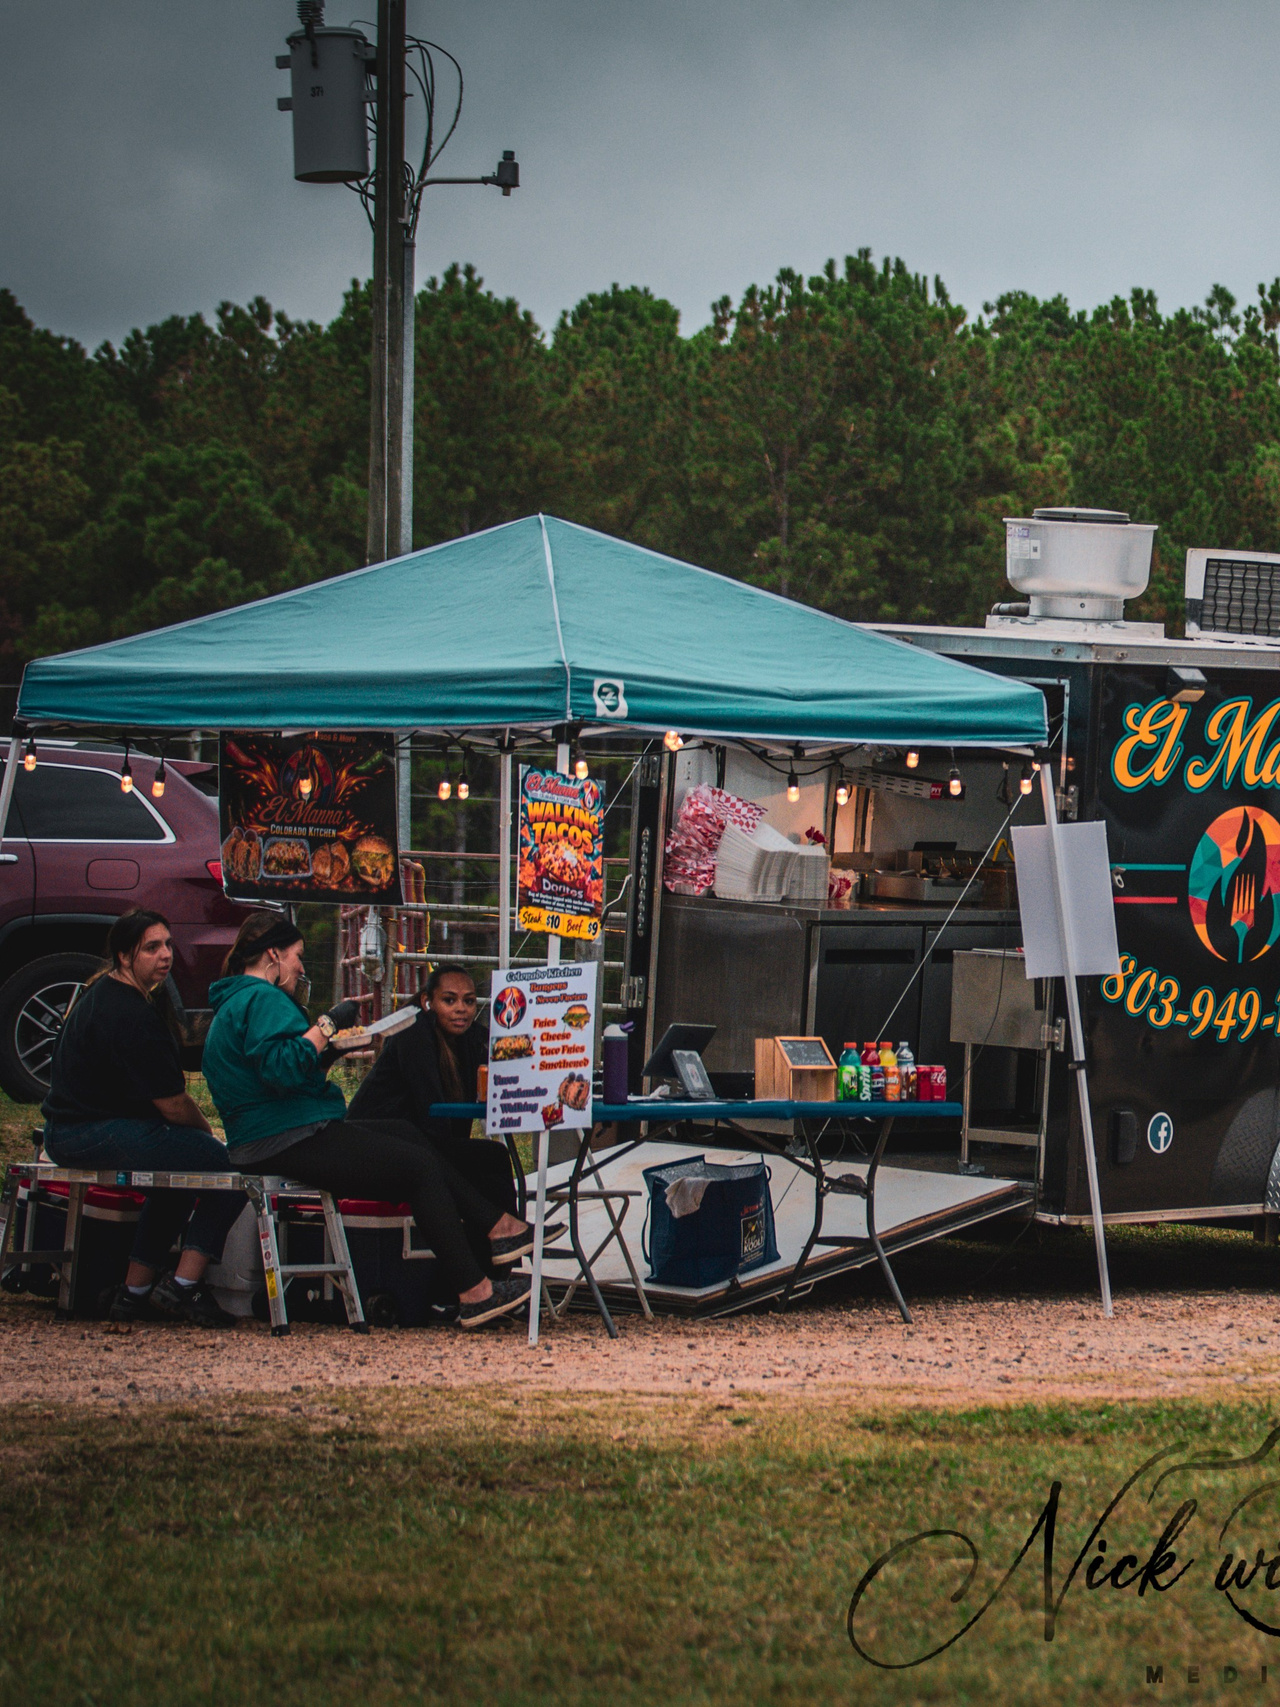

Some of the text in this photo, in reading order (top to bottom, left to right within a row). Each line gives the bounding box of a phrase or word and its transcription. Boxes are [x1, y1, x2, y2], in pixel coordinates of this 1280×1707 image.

[1111, 695, 1192, 793] El
[525, 772, 542, 791] El
[540, 776, 580, 799] Manna
[258, 795, 345, 825] El Manna
[527, 801, 599, 836] WALKING
[270, 823, 336, 838] COLORADO KITCHEN
[532, 821, 594, 854] TACOS
[542, 877, 584, 899] Doritos
[522, 911, 598, 936] Steak $10 Beef $9
[506, 967, 582, 982] Colorado Kitchen
[529, 982, 568, 993] Burgers
[533, 1018, 557, 1028] Fries
[540, 1031, 572, 1042] Cheese
[540, 1044, 586, 1056] Taco Fries
[539, 1057, 589, 1071] Smothered
[500, 1101, 539, 1114] Walking
